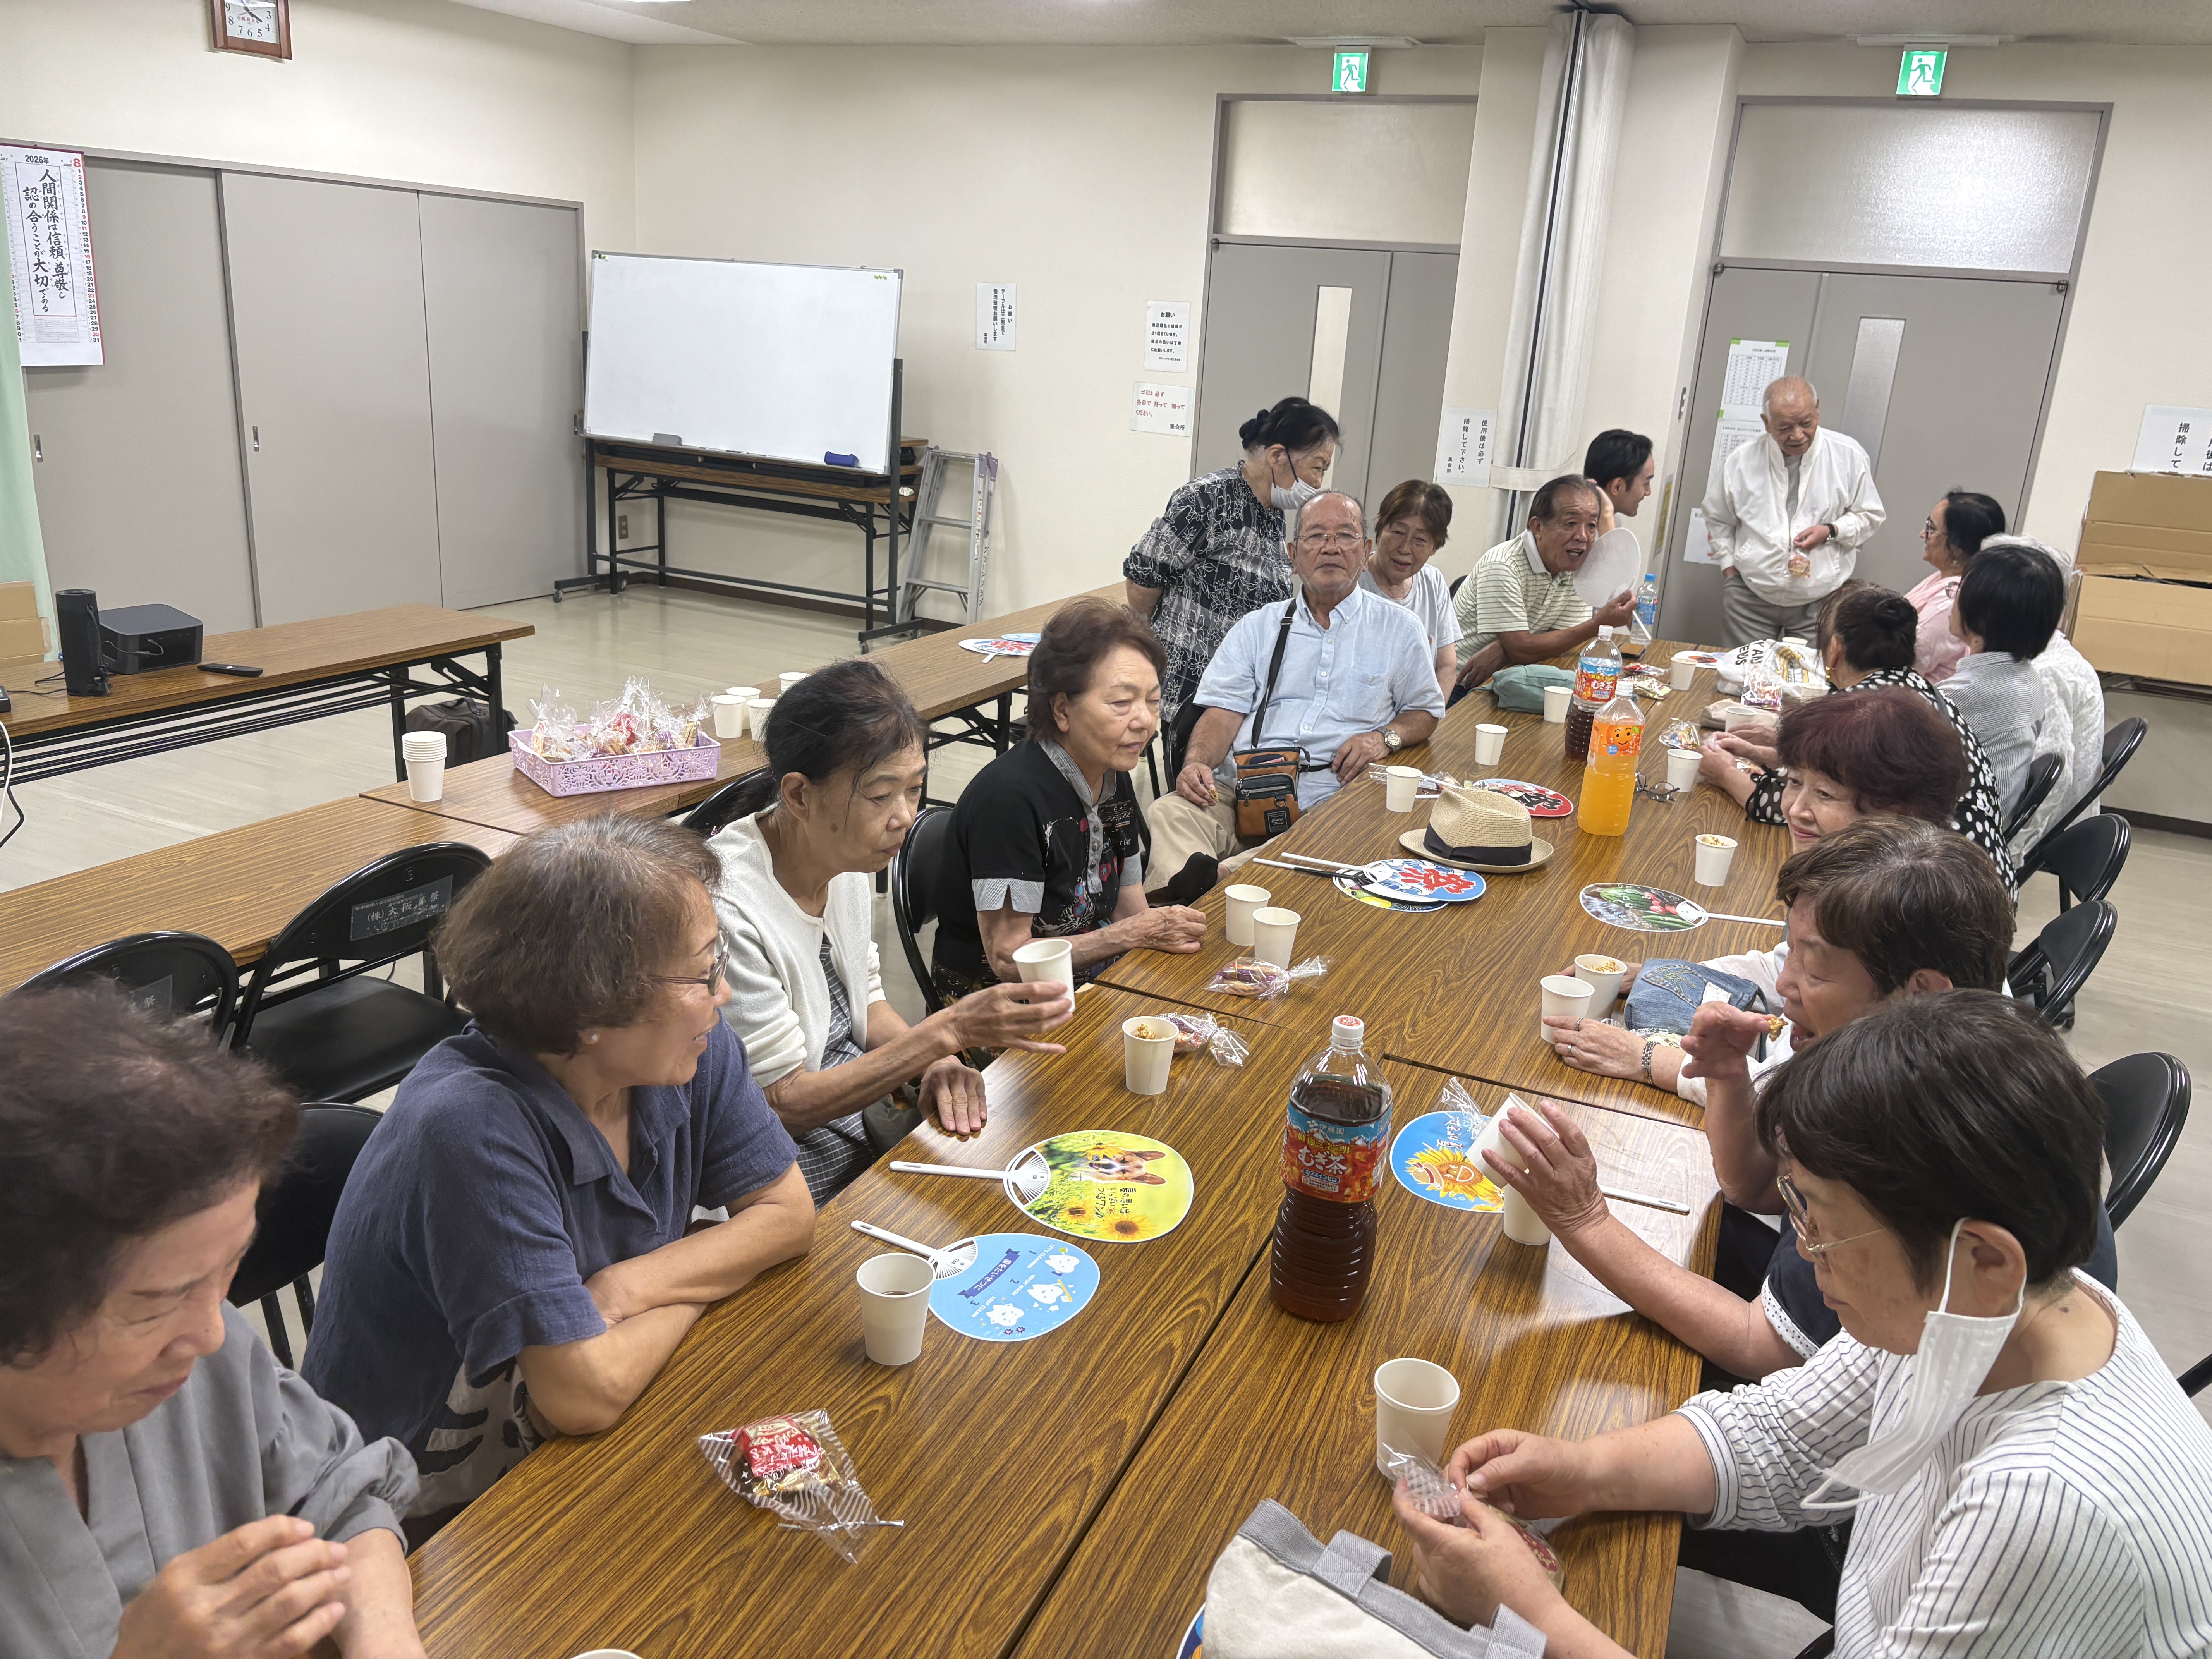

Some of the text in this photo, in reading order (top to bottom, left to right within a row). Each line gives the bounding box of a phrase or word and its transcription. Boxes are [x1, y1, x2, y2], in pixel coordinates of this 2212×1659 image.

[226, 3, 230, 11] 9
[228, 16, 234, 25] 8
[266, 11, 271, 19] 3
[238, 26, 243, 34] 7
[247, 28, 252, 37] 6
[258, 29, 262, 37] 5
[265, 23, 270, 31] 4
[25, 155, 49, 164] 2026年
[73, 158, 81, 167] 8
[22, 186, 49, 313] 認め合うことが大切である
[1458, 418, 1470, 473] 掃除して下さい。
[1477, 419, 1488, 465] 使用後は必ず
[2171, 422, 2190, 468] 掃除して
[1591, 680, 1614, 690] むぎ茶
[1319, 1123, 1345, 1135] 伊藤園
[1298, 1132, 1352, 1154] 健康ミネラル
[1298, 1145, 1348, 1175] むぎ茶
[1304, 1170, 1338, 1182] カフェインゼロ
[1108, 1188, 1117, 1207] いっぱい
[1120, 1187, 1136, 1214] 夏の思い出
[973, 1259, 1012, 1291] 歯をたいせつに
[1011, 1274, 1036, 1296] WASH WASH
[971, 1305, 986, 1317] CLEAN
